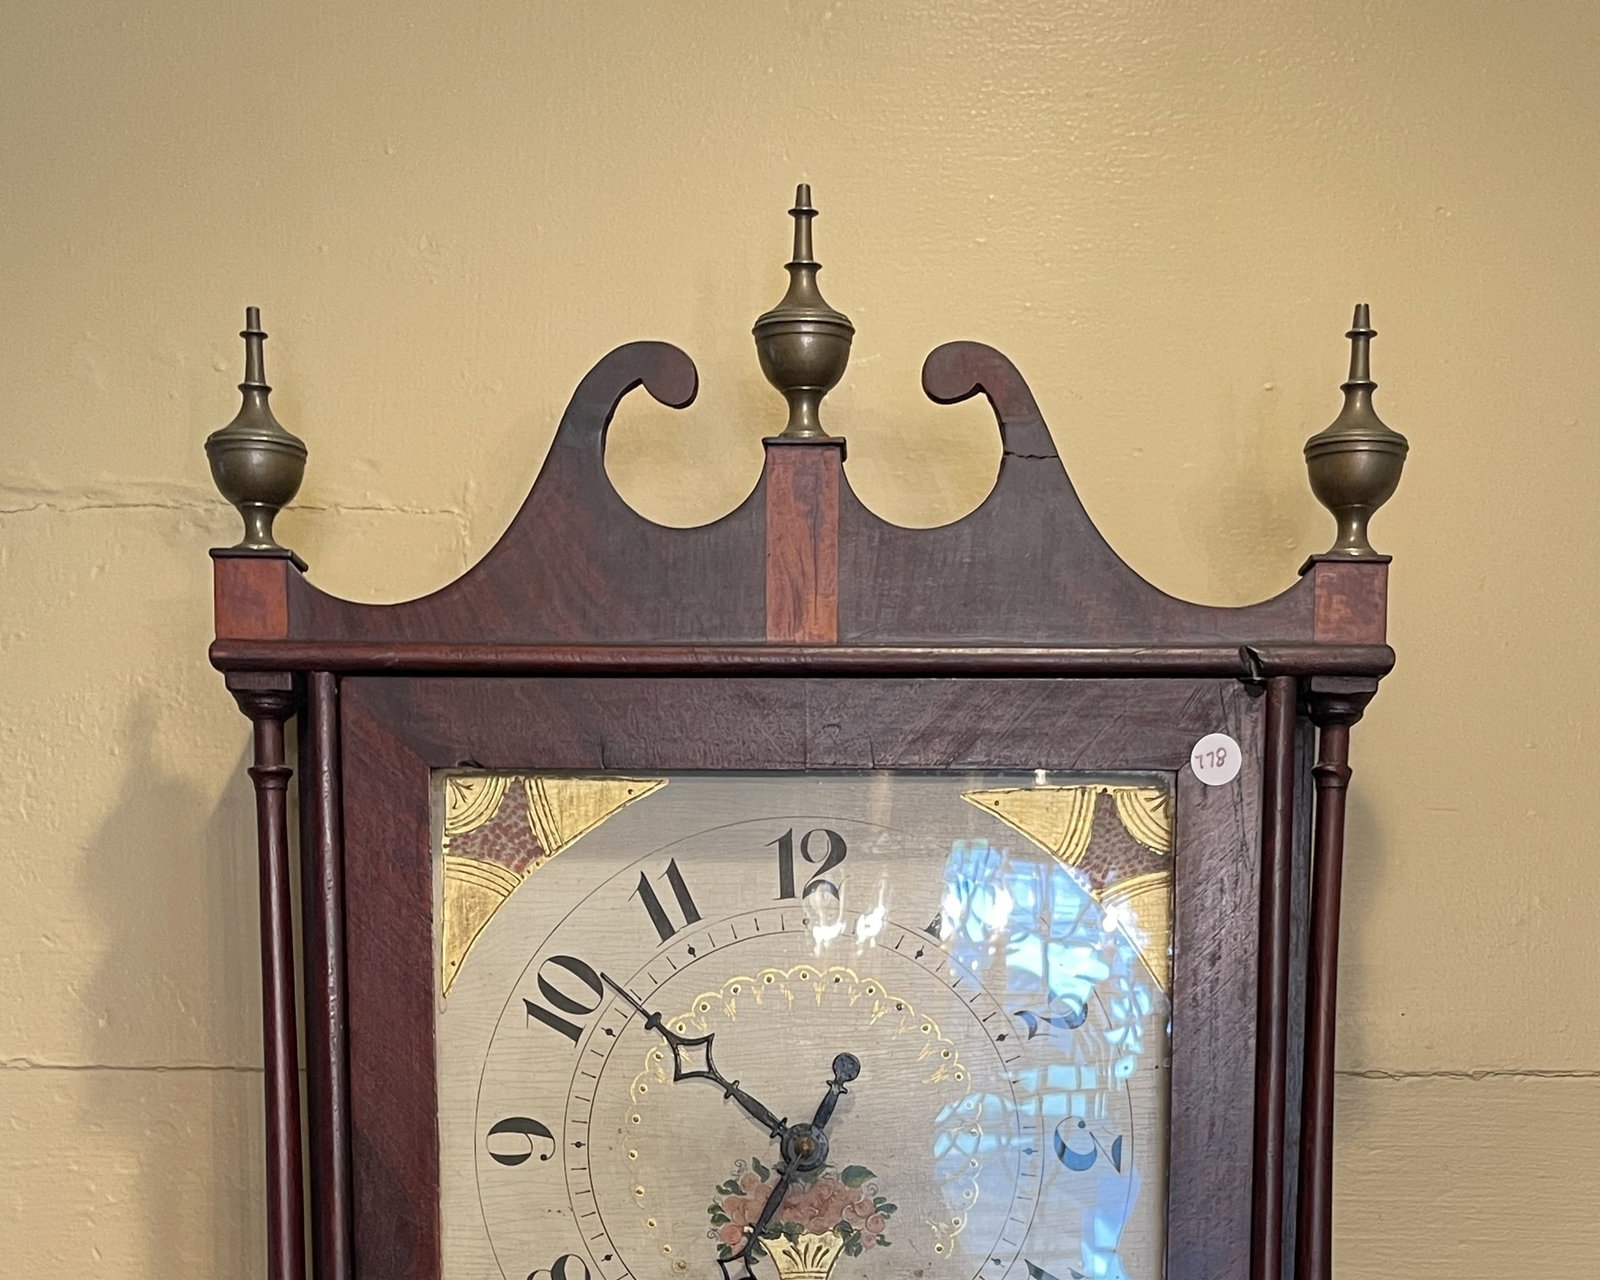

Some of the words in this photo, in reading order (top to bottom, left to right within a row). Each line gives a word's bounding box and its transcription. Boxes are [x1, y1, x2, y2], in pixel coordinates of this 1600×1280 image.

[764, 828, 848, 902] 12
[628, 857, 703, 948] 11
[523, 955, 605, 1048] 10
[485, 1116, 556, 1167] 9
[1053, 1115, 1123, 1174] 3
